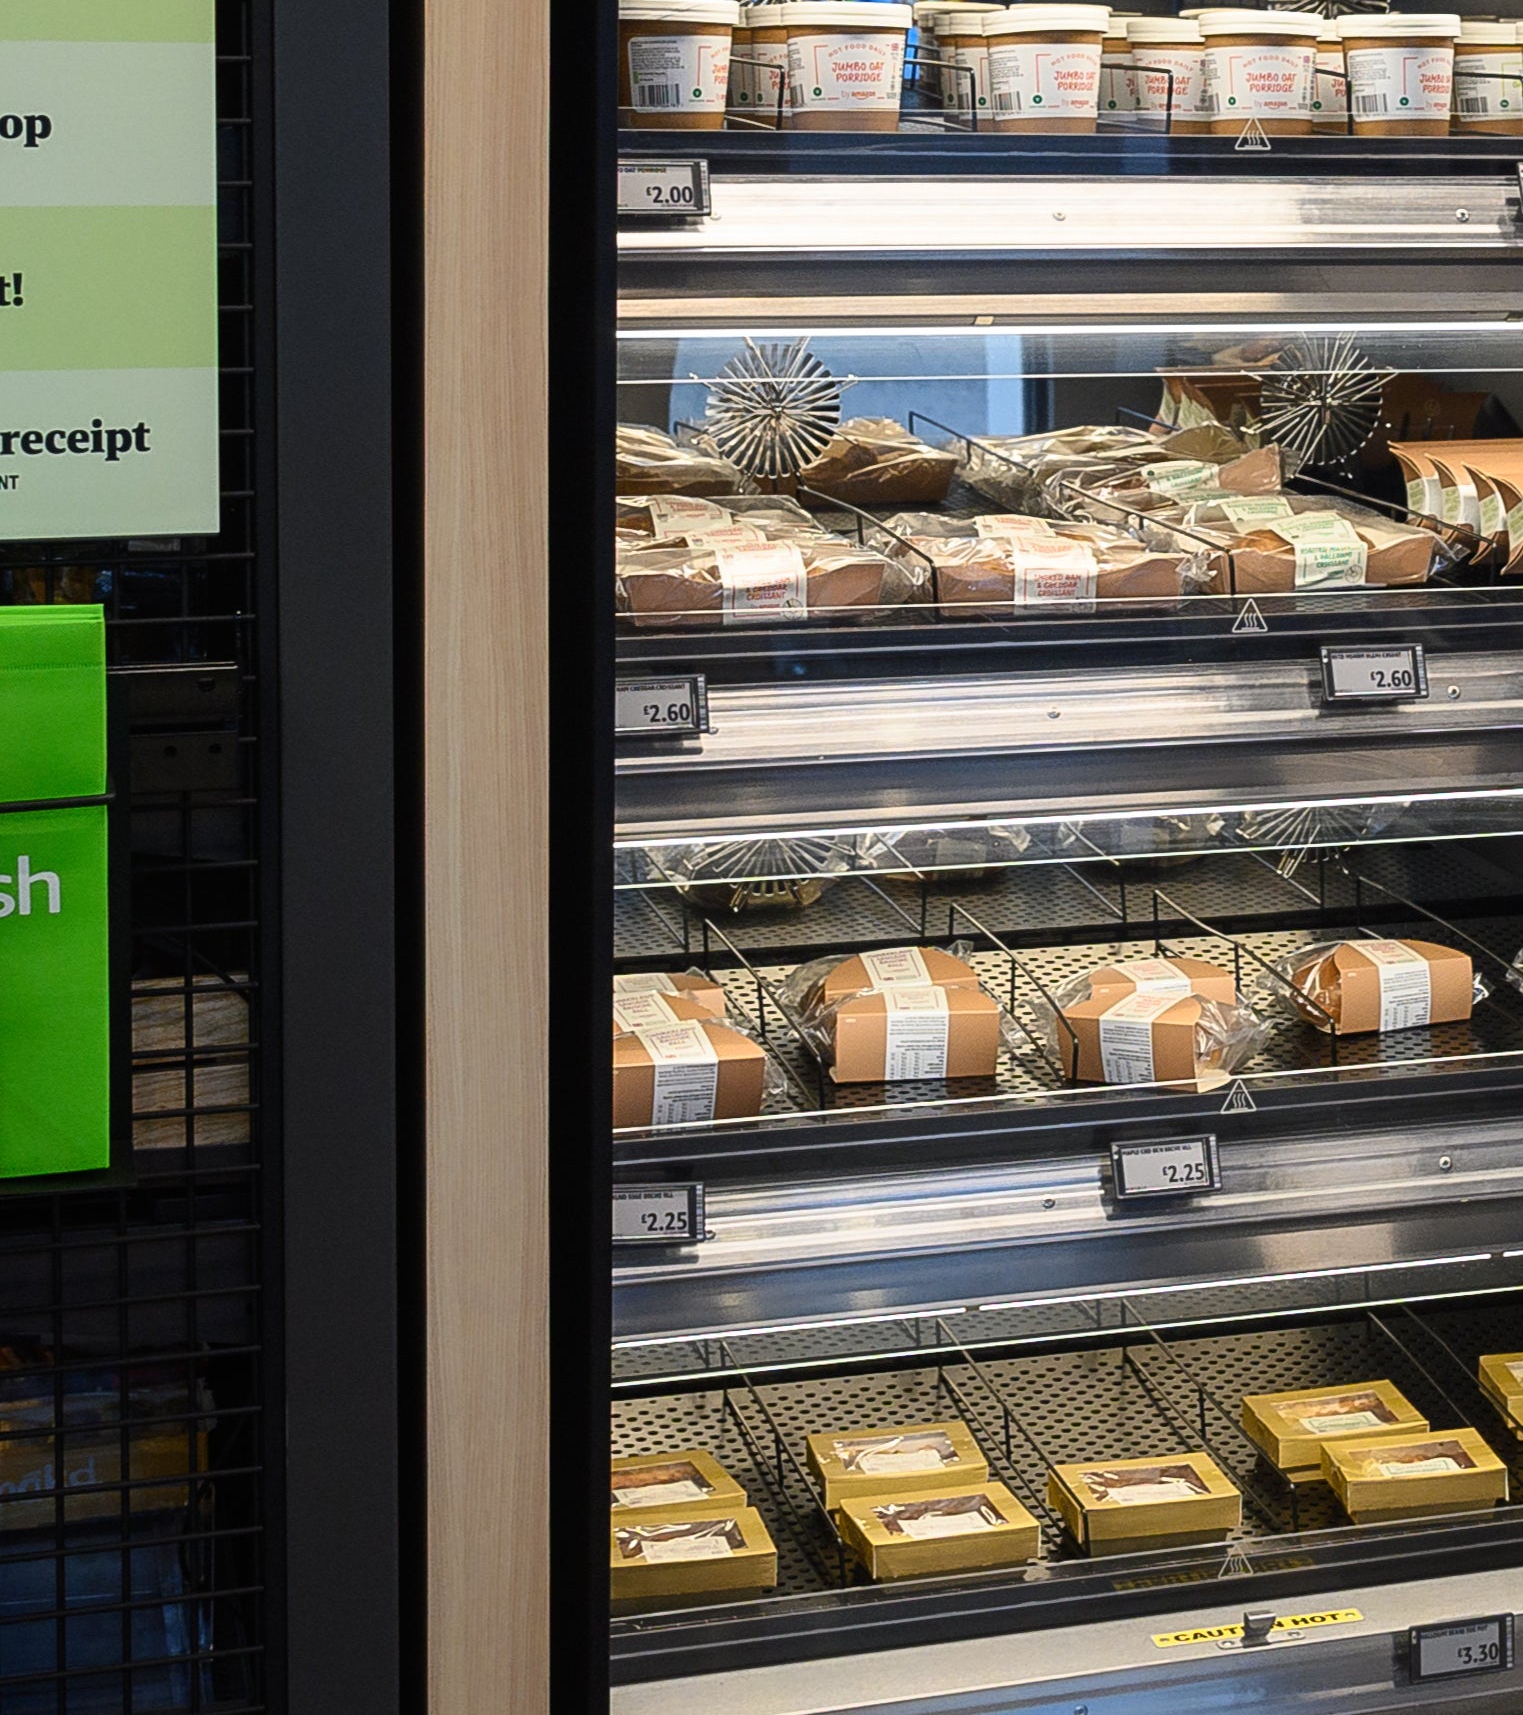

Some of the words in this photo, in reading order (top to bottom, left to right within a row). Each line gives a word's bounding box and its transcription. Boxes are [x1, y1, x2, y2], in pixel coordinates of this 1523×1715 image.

[831, 62, 866, 73] JUMBO
[868, 61, 885, 72] OAT
[835, 72, 882, 83] PORRIDGE
[1245, 72, 1279, 83] JUMBO
[1281, 73, 1298, 83] OAT
[851, 91, 877, 100] amazon
[1249, 83, 1294, 93] PORRIDGE
[1263, 101, 1288, 110] amazon
[646, 186, 693, 203] £2.00
[0, 418, 151, 462] receipt
[1370, 670, 1412, 688] £2.60
[643, 703, 691, 723] £2.60
[1162, 1162, 1204, 1183] £2.25
[641, 1211, 687, 1232] £2.25
[1174, 1620, 1285, 1643] CAUTN
[1289, 1612, 1340, 1629] HOT
[1457, 1641, 1498, 1665] £3.30
